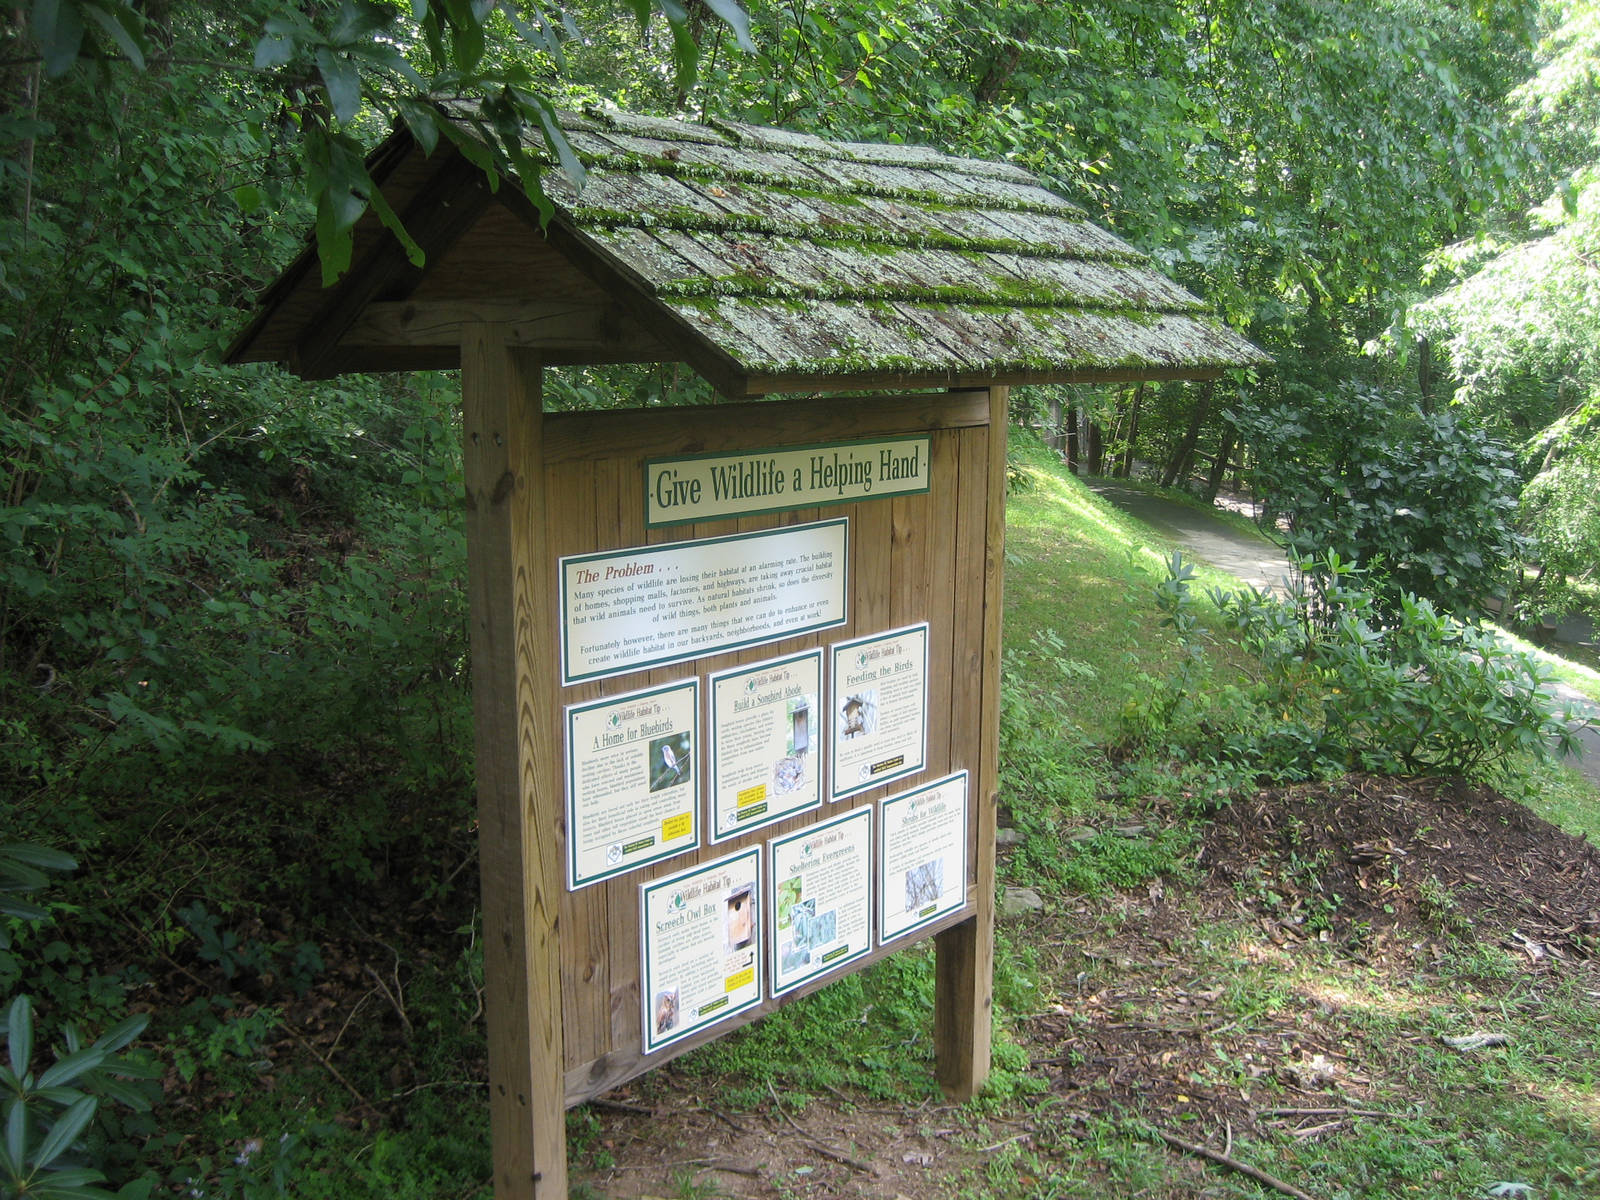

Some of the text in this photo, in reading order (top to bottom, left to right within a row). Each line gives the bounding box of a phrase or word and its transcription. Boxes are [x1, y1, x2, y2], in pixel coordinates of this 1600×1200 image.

[656, 445, 919, 508] Give Wildlife a Helping Hand
[574, 591, 594, 601] Many
[598, 585, 624, 598] species
[627, 583, 634, 592] of
[637, 578, 664, 590] wildlife
[680, 572, 699, 583] losing
[702, 570, 716, 579] their
[719, 567, 739, 577] habitat
[759, 560, 784, 570] alarming
[812, 551, 833, 561] building
[574, 604, 581, 612] of
[585, 601, 610, 612] homes,
[613, 595, 644, 608] shopping
[648, 590, 668, 600] malls,
[670, 586, 700, 596] factories,
[703, 581, 714, 590] and
[760, 572, 778, 581] taking
[780, 569, 793, 578] away
[796, 565, 814, 574] crucial
[816, 561, 832, 570] habitat
[576, 569, 599, 584] The
[605, 562, 654, 580] Problem
[573, 616, 586, 625] that
[590, 612, 605, 622] wild
[608, 607, 636, 619] animals
[639, 604, 656, 613] need
[668, 598, 694, 608] survive.
[708, 592, 730, 602] natural
[732, 588, 754, 598] habitats
[787, 578, 799, 586] does
[801, 575, 809, 583] the
[652, 615, 660, 623] of
[663, 611, 676, 621] wild
[680, 607, 700, 618] things,
[703, 604, 716, 613] both
[720, 601, 737, 611] plants
[740, 597, 751, 605] and
[580, 640, 620, 654] Fortunately
[624, 634, 655, 646] however,
[658, 629, 675, 639] there
[691, 623, 708, 633] many
[711, 619, 729, 629] things
[732, 616, 743, 624] that
[785, 604, 807, 613] enhance
[589, 655, 610, 664] create
[614, 649, 640, 659] wildlife
[643, 643, 665, 654] habitat
[691, 632, 724, 645] backyards,
[774, 619, 783, 627] and
[846, 659, 913, 685] Feeding the Birds
[734, 697, 749, 712] Build
[757, 689, 781, 704] Songbird
[785, 683, 801, 697] Abode
[593, 717, 672, 749] A Home for Bluebirds
[790, 844, 855, 873] Sheltering Evergreens
[703, 881, 720, 894] Habitat
[656, 904, 716, 932] Screech Owl Box
